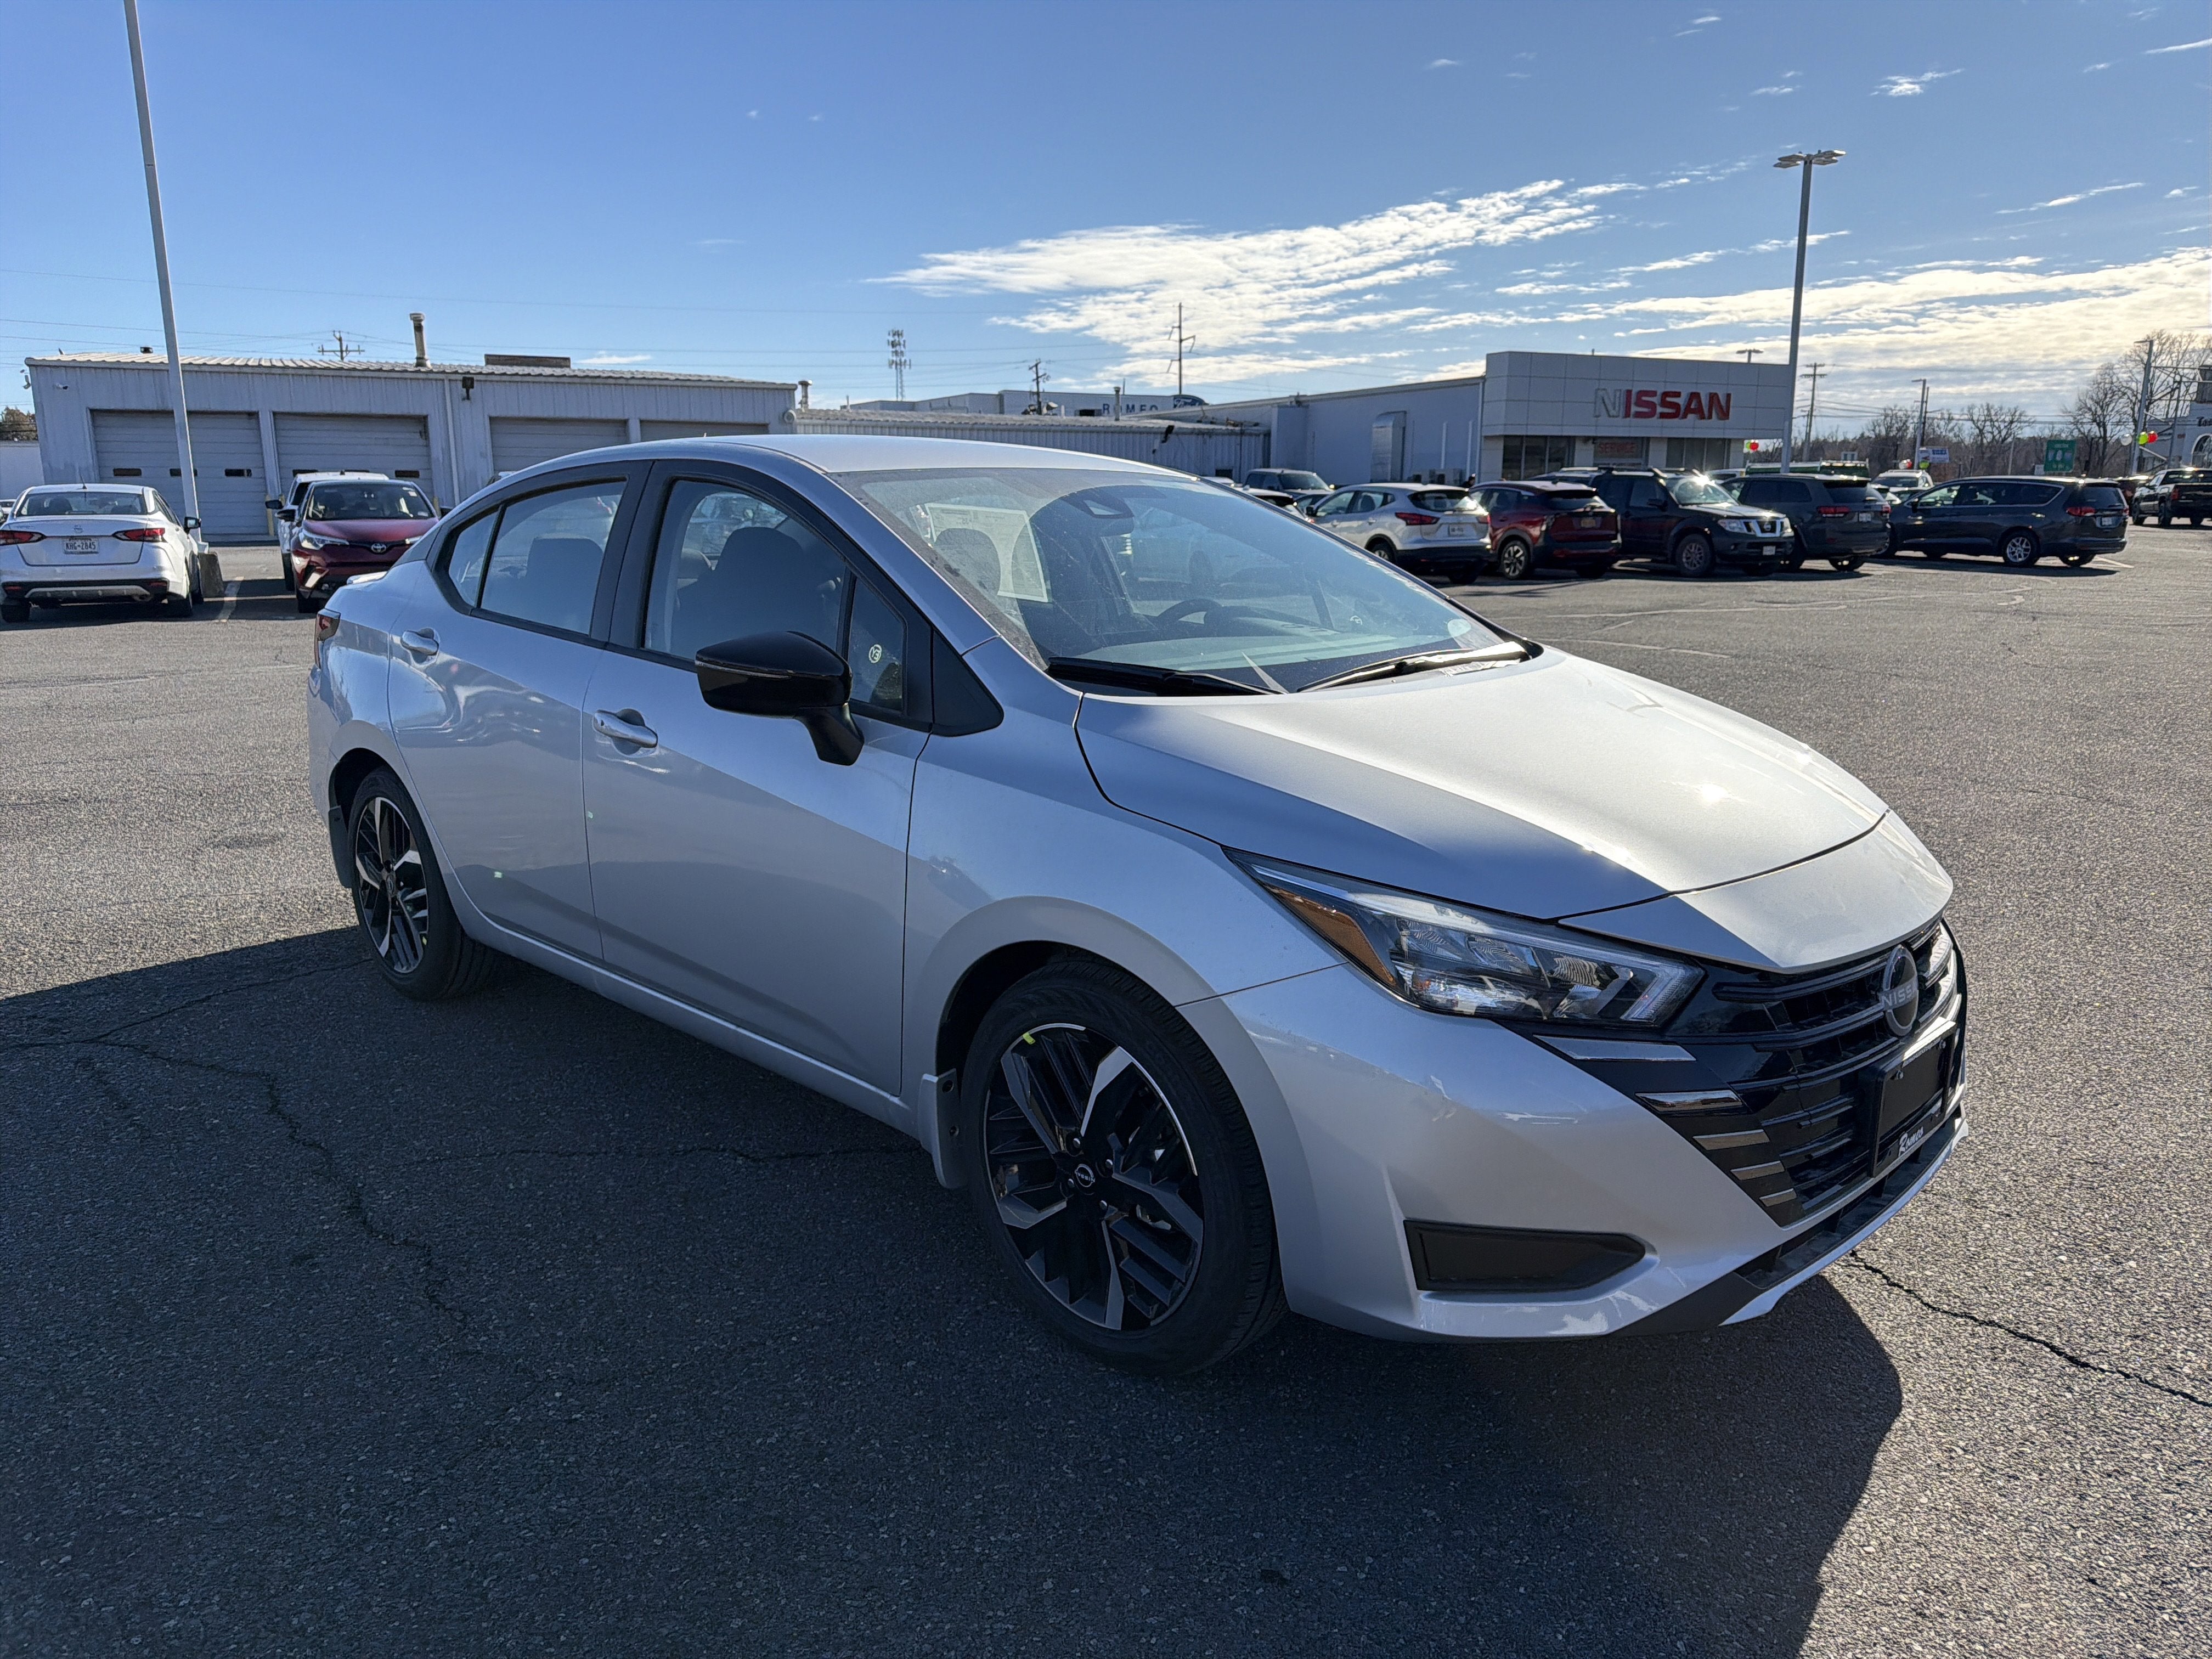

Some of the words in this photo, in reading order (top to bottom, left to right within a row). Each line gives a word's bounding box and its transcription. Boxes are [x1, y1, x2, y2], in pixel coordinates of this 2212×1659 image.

[1594, 388, 1732, 421] NISSAN
[1881, 981, 1918, 1007] NISS
[1898, 1126, 1924, 1157] Romeo
